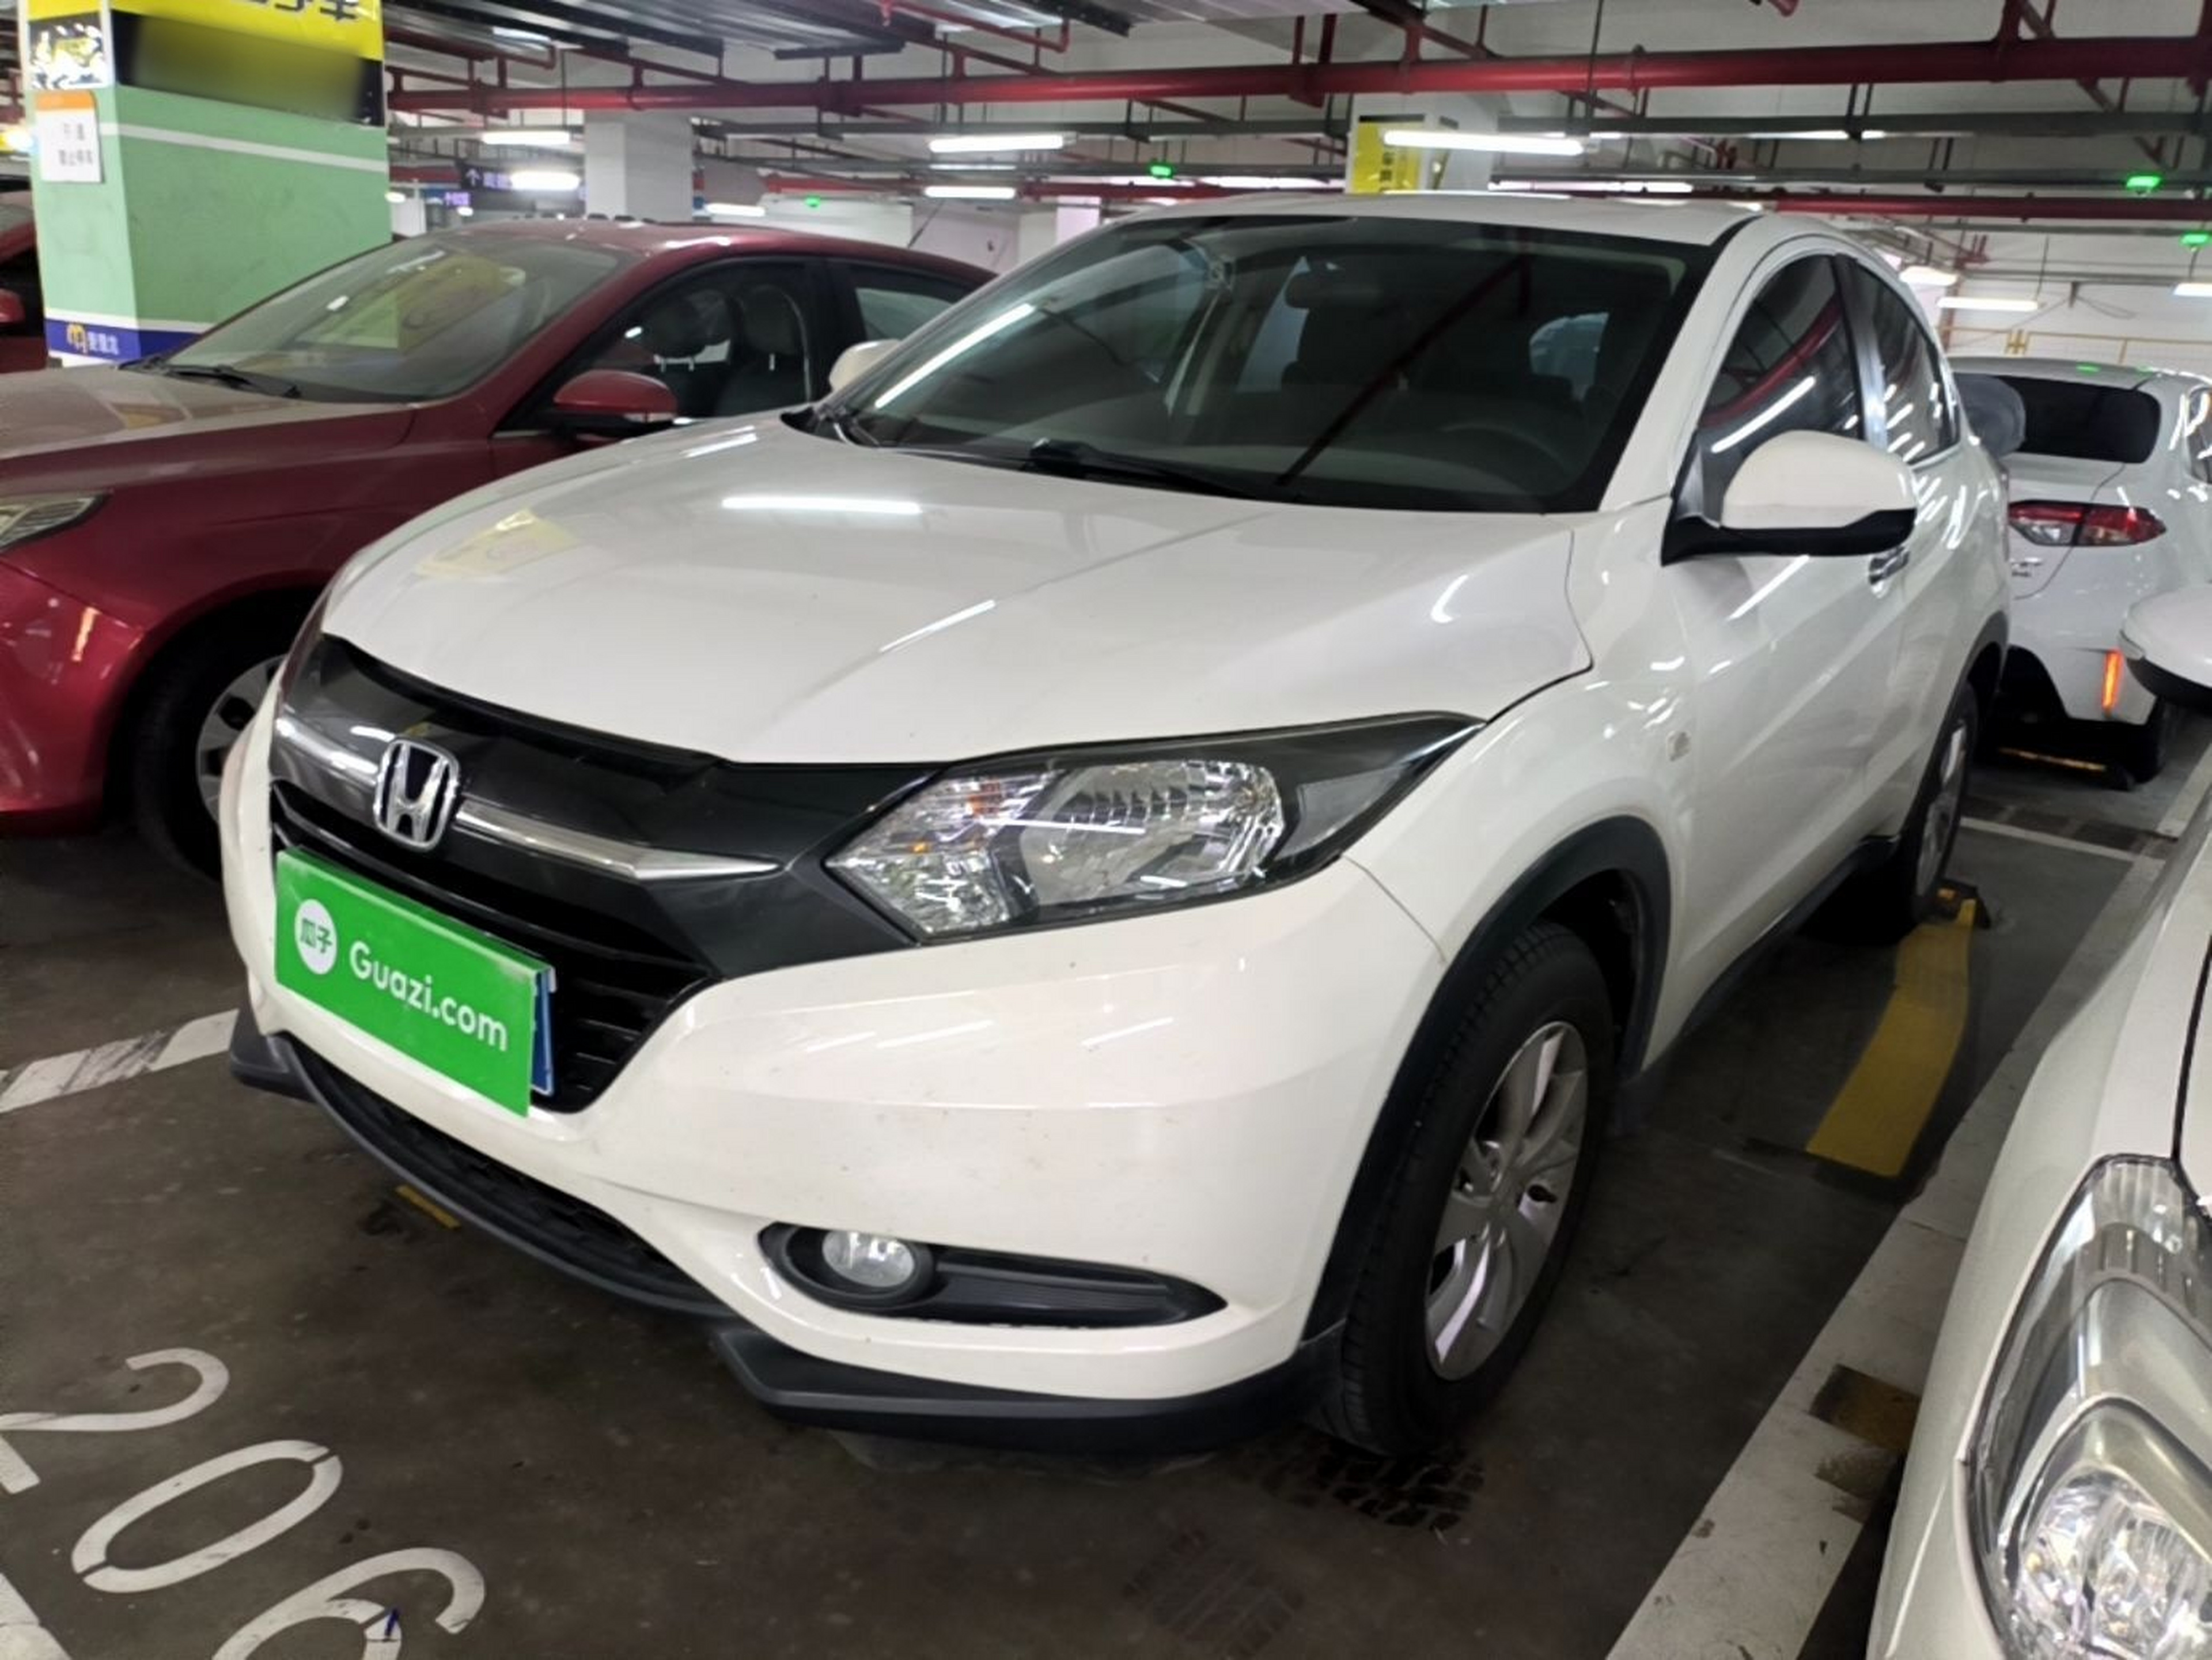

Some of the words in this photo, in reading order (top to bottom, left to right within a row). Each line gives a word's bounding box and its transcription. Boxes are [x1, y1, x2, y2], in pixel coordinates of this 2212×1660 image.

[300, 918, 333, 954] 瓜子
[349, 940, 507, 1052] Guazi.com
[0, 1348, 485, 1660] 206
